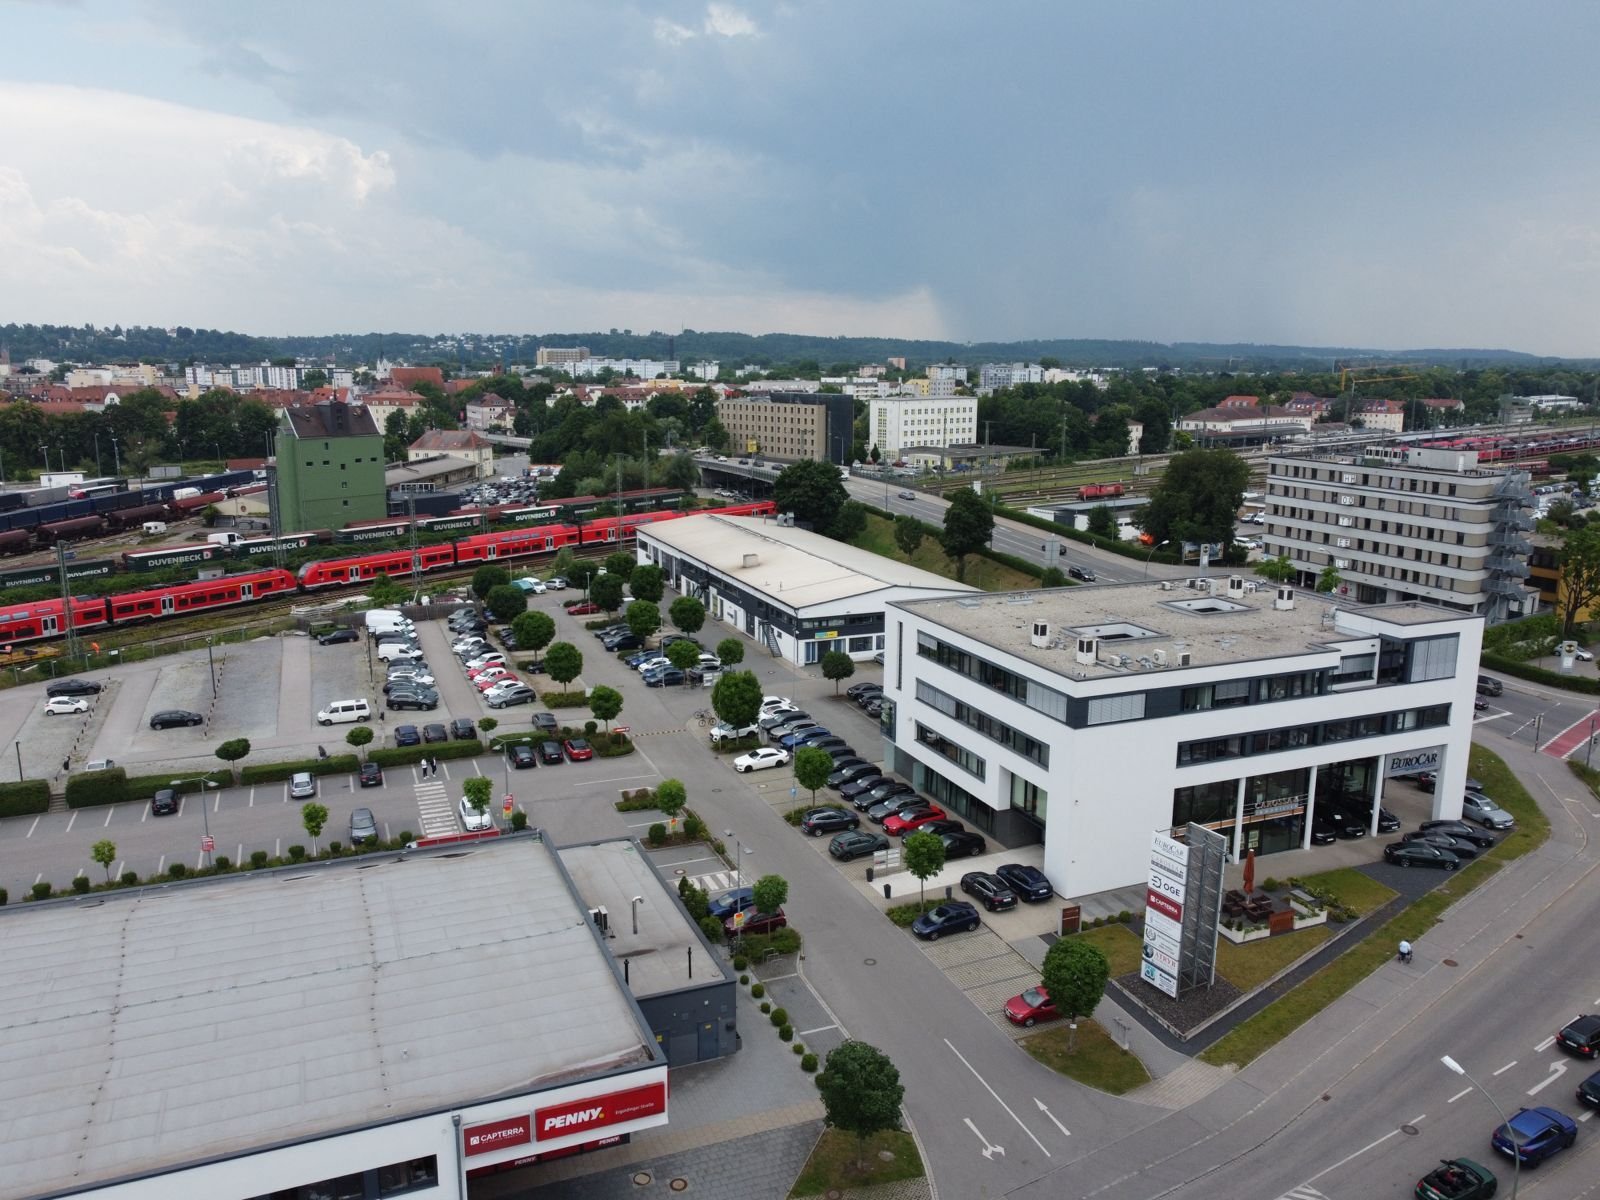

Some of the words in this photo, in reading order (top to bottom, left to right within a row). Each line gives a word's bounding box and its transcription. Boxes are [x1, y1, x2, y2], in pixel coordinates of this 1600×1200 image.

[433, 520, 473, 531] DUVENBECK
[353, 530, 395, 541] DUVENBECK
[148, 553, 201, 567] DUVENBECK
[1163, 883, 1181, 897] OGE
[480, 1126, 525, 1142] CAPTERRA
